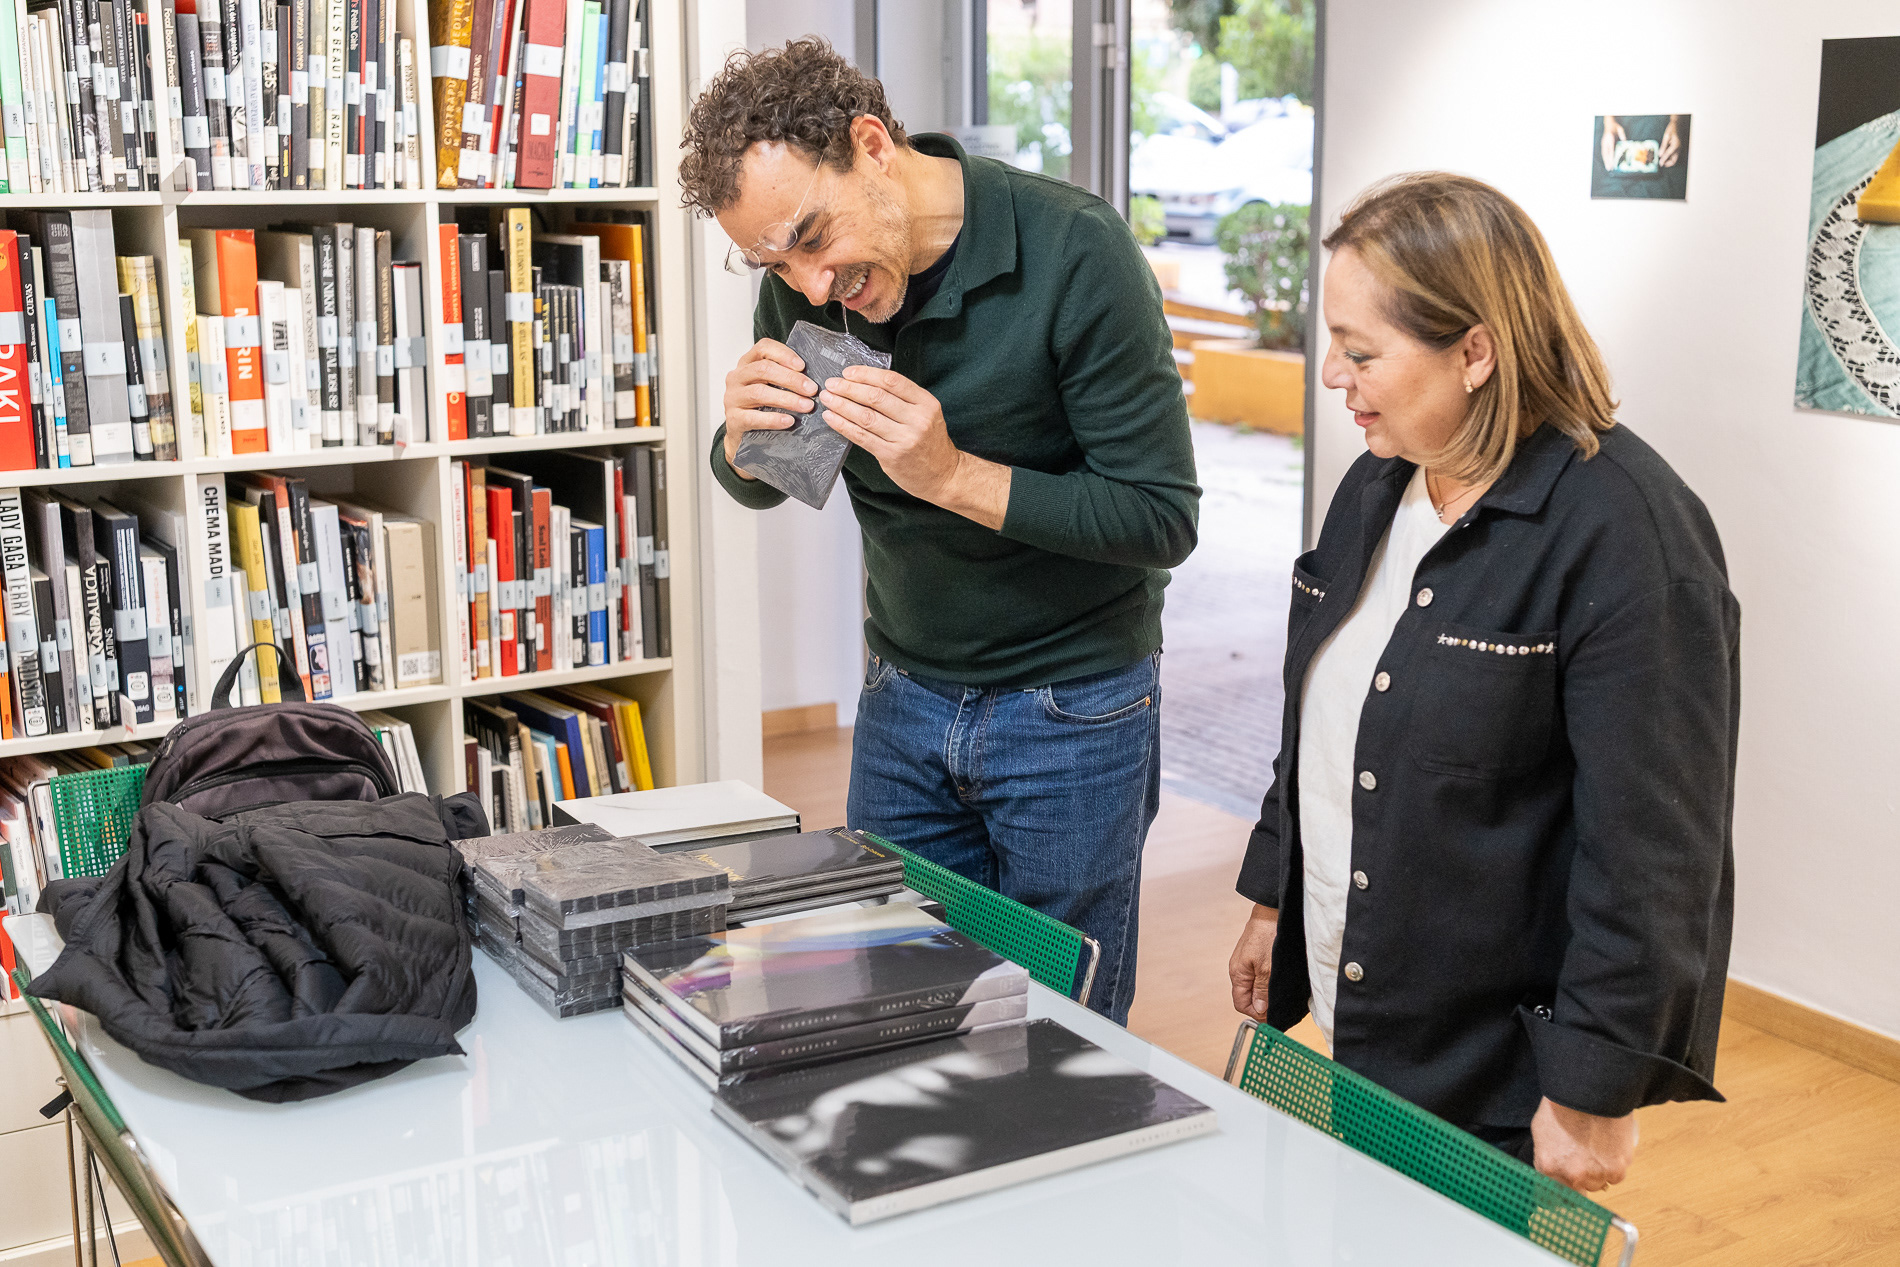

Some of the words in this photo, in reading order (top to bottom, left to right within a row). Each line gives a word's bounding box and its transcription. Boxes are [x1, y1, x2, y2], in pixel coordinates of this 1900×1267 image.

[115, 7, 123, 37] FLAMENCO
[163, 8, 174, 29] Focal
[165, 29, 176, 50] Book
[349, 32, 359, 50] Girls
[23, 252, 29, 260] 2
[448, 238, 457, 290] FOTOGRÁFICA
[27, 283, 36, 316] CUEVAS
[305, 309, 316, 353] ESPAÑOLA
[0, 496, 20, 531] LADY
[203, 486, 221, 539] CHEMA
[3, 533, 25, 572] GAGA
[208, 541, 224, 581] MAD
[8, 575, 32, 617] TERRY
[105, 628, 117, 661] LATINS
[780, 1013, 838, 1030] UNIVERSOS
[927, 1016, 956, 1028] DAVID
[780, 1039, 838, 1055] UNIVERSOS
